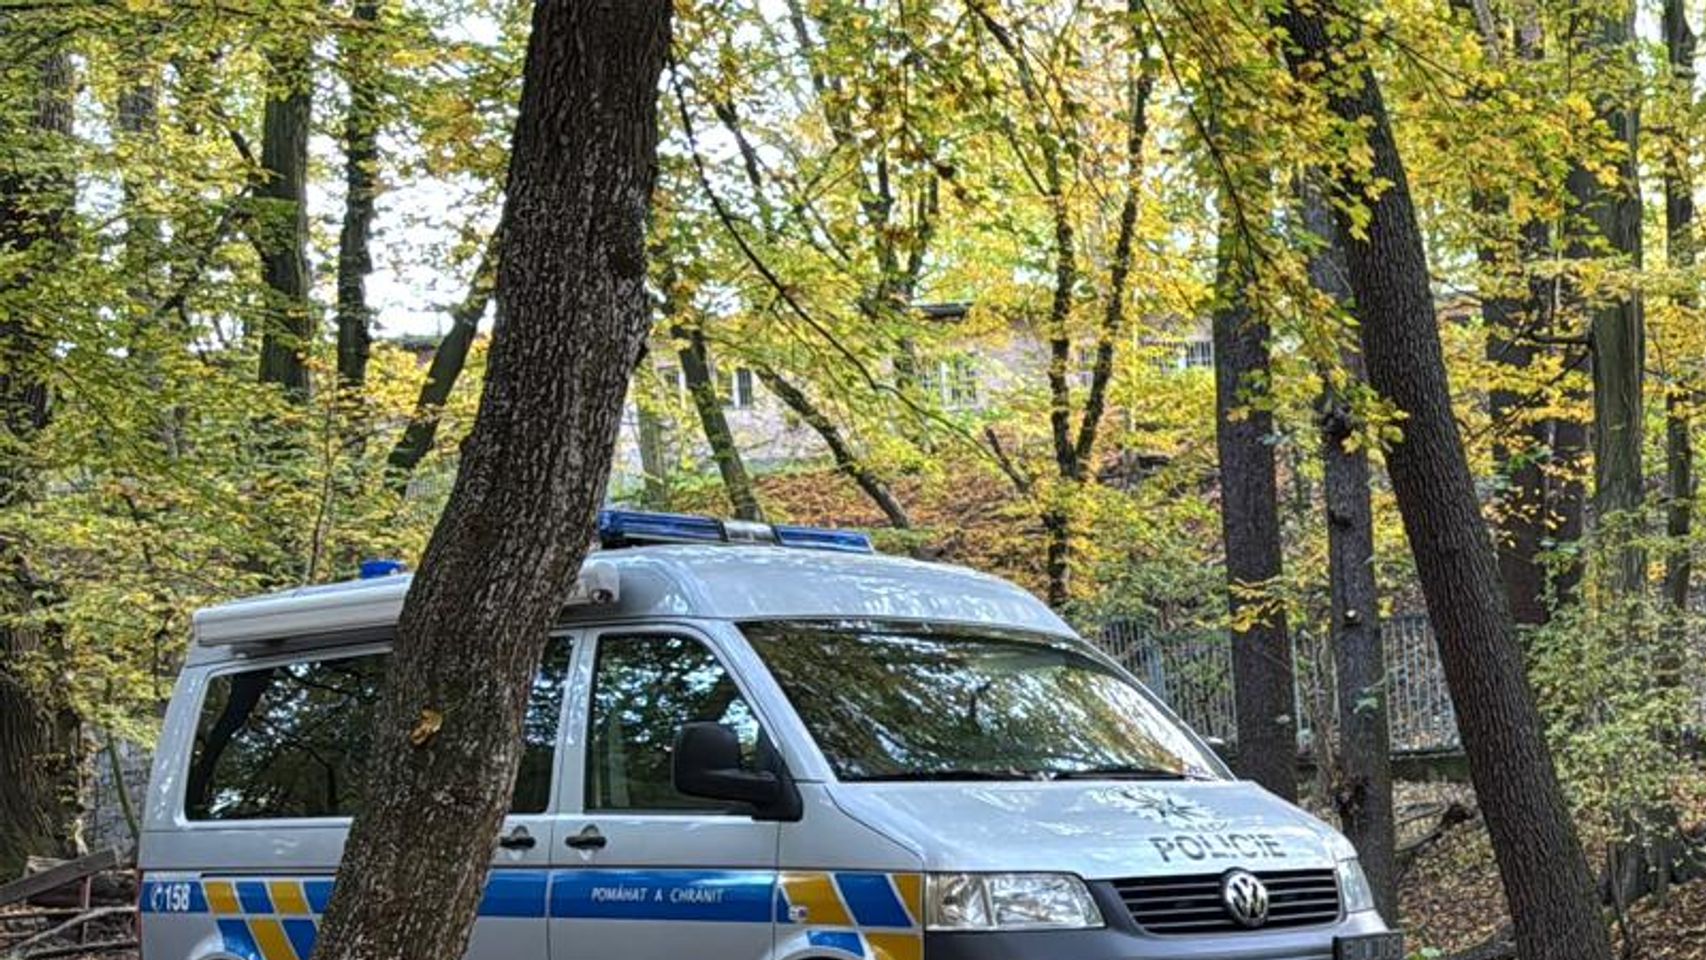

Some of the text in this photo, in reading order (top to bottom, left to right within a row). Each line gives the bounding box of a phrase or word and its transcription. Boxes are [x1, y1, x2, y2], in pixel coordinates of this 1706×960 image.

[1150, 832, 1288, 863] POLICIE
[166, 882, 191, 912] 158
[590, 882, 648, 903] POMÁHAT
[654, 887, 663, 903] A
